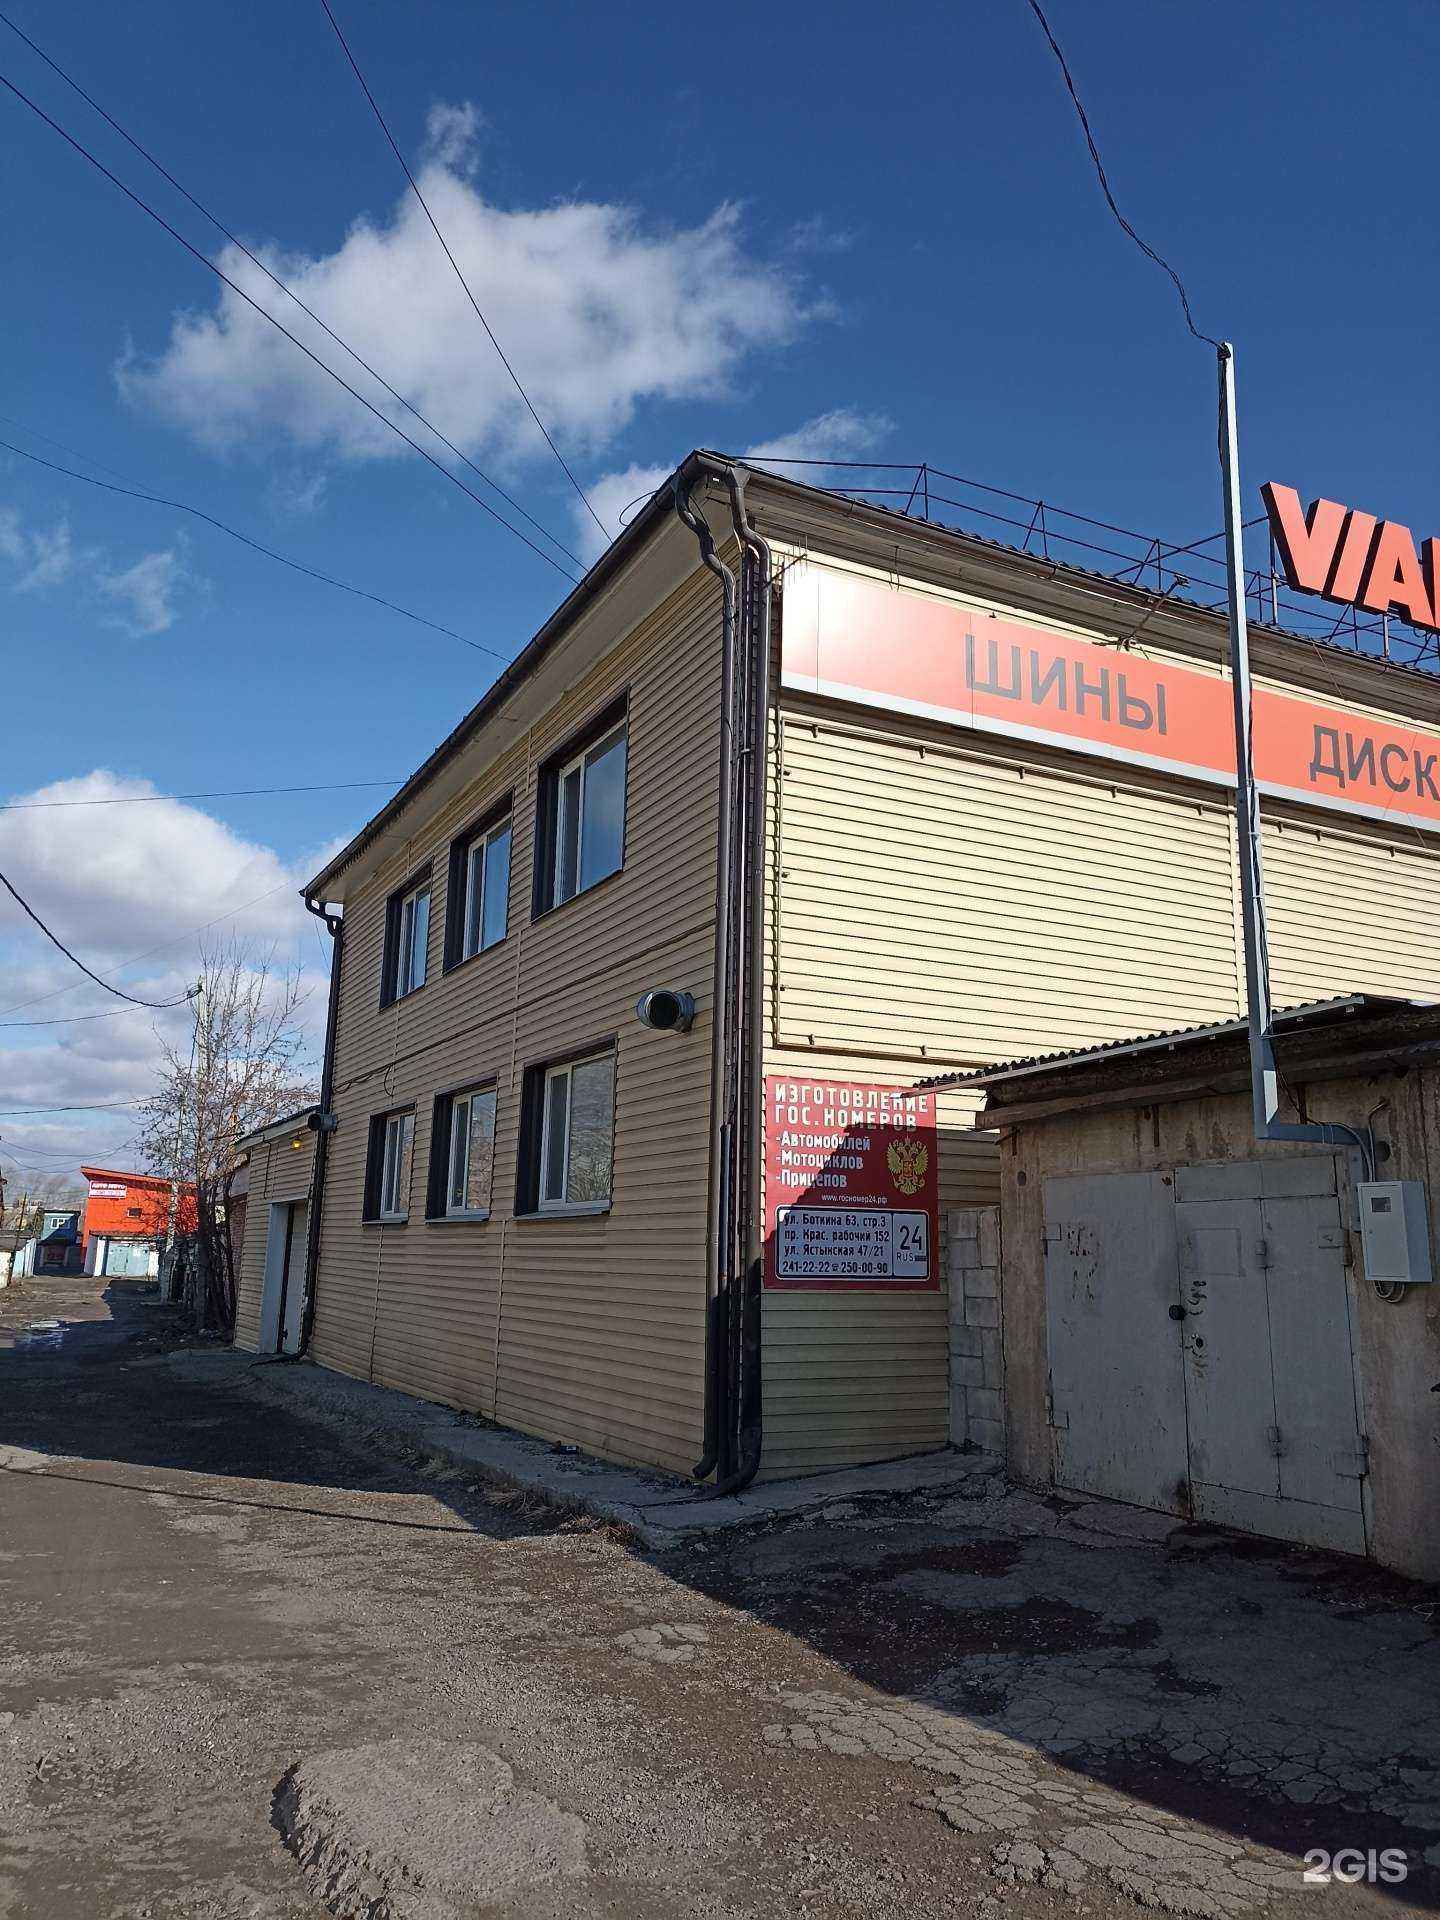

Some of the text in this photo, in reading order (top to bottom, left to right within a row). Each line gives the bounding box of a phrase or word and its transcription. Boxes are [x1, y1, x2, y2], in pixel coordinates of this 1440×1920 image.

[965, 634, 1167, 735] ШИНЫ
[1310, 725, 1440, 800] ДИСК
[775, 1083, 928, 1112] ИЗГОТОВЛЕНИЕ
[775, 1104, 917, 1132] ГОС. НОМЕРОВ
[776, 1130, 871, 1151] -Автомобилей
[776, 1150, 864, 1170] -Мотоциклов
[784, 1214, 799, 1226] ул.
[802, 1213, 842, 1227] Боткина
[784, 1229, 889, 1243] пр. Крас. рабочий 152
[899, 1225, 922, 1251] 24
[784, 1244, 884, 1257] ул. Ястынская 47/21
[896, 1252, 914, 1262] RUS
[783, 1260, 888, 1274] 241-22-22 250-00-90
